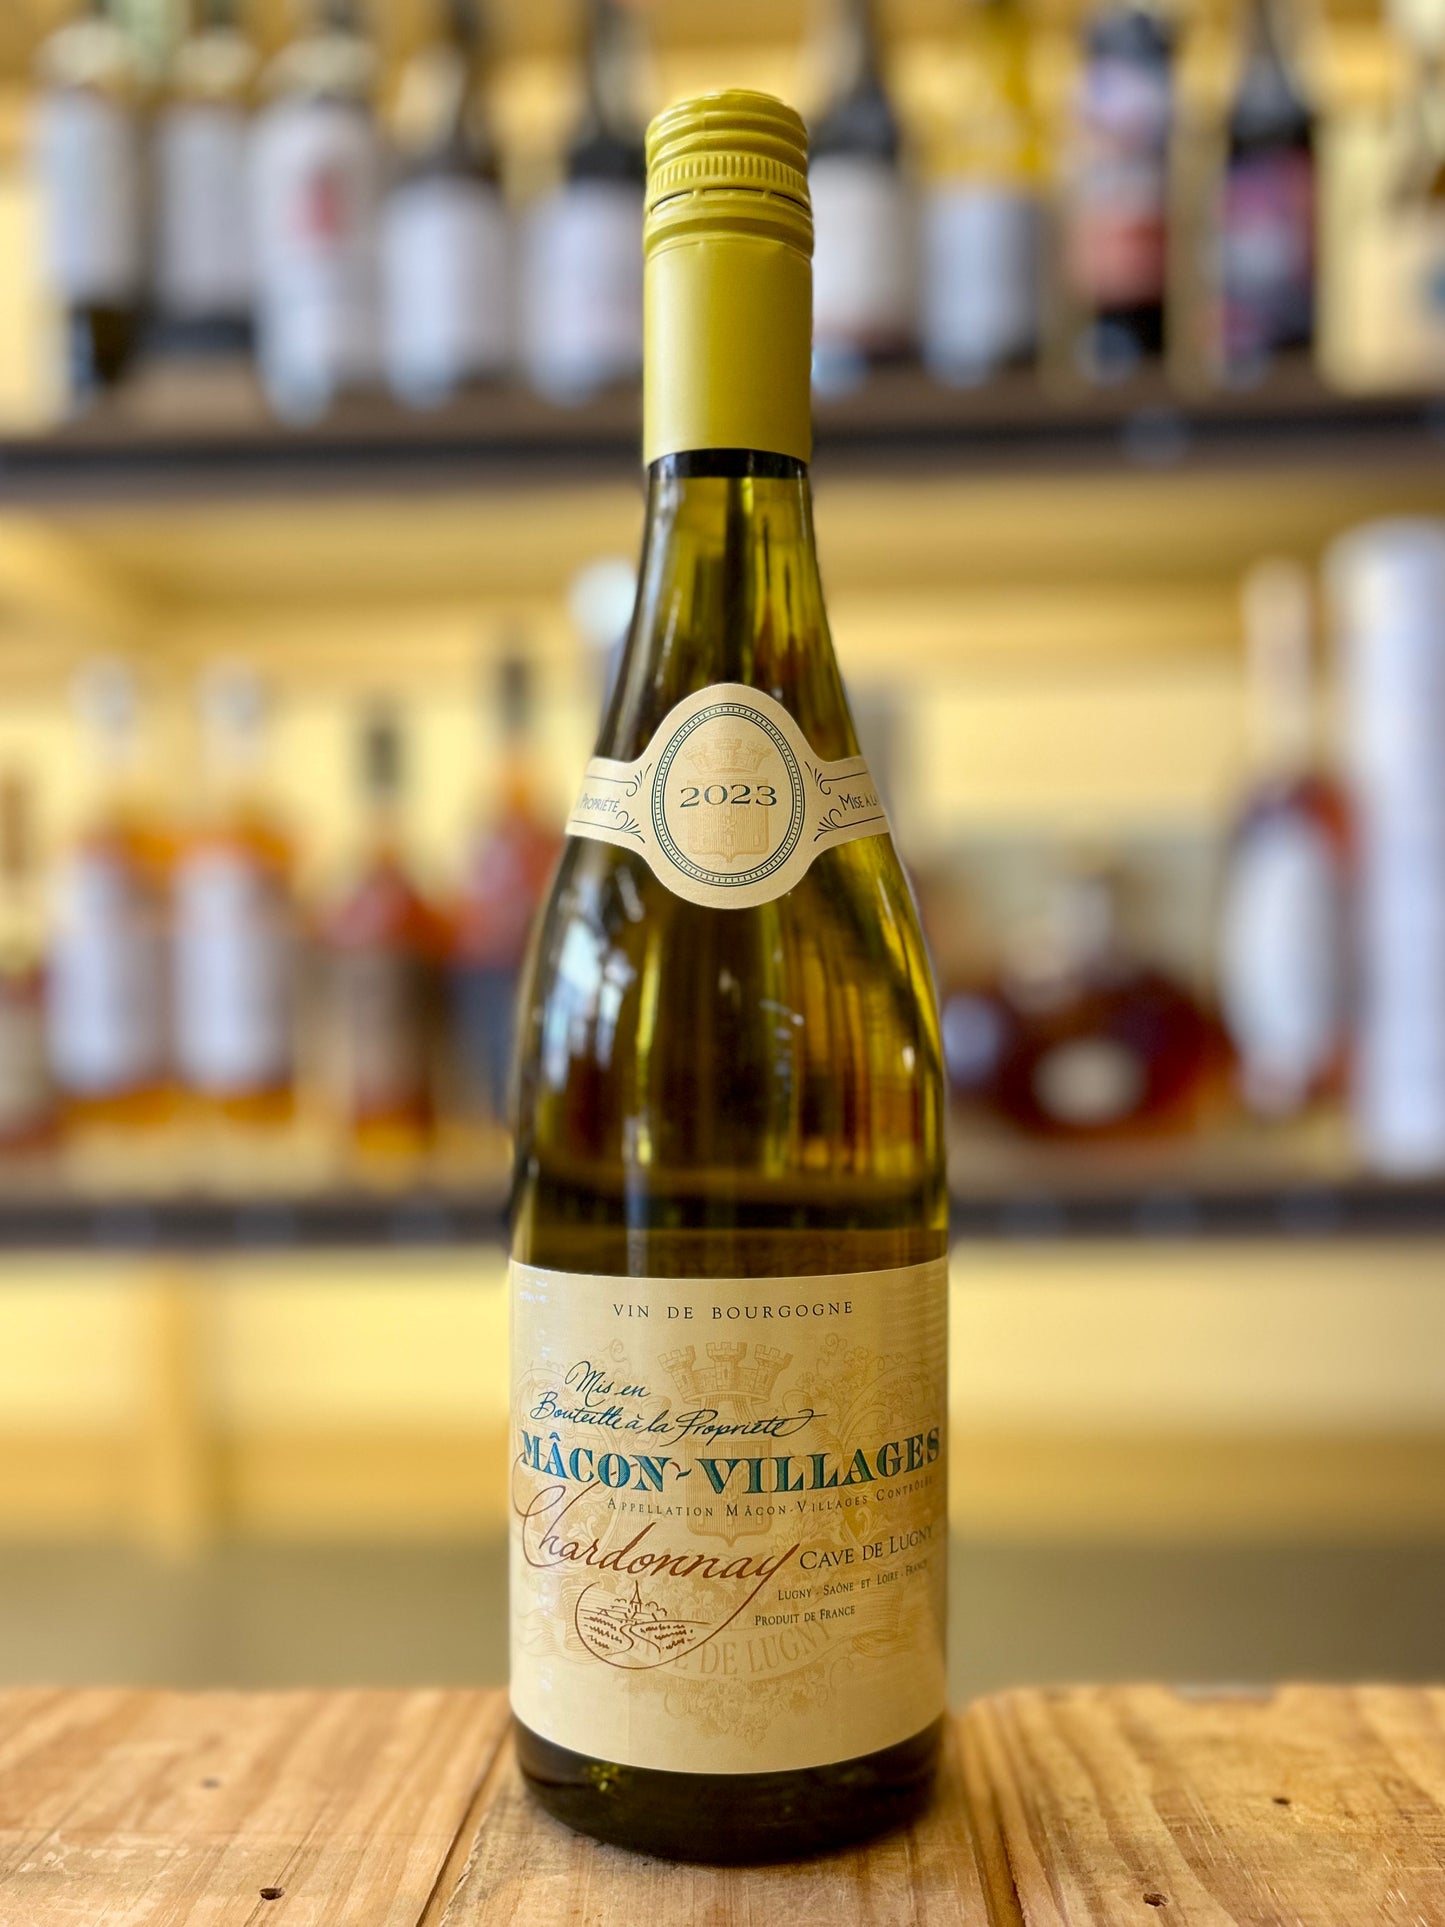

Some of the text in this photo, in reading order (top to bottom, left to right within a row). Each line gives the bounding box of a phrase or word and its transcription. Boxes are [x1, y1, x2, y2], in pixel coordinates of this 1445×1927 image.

[680, 784, 777, 808] 2023
[613, 1301, 853, 1320] VIN DE BOURGOGNE
[565, 1360, 651, 1407] Mis en
[530, 1391, 624, 1430] Bouteille
[624, 1413, 644, 1429] à
[635, 1410, 676, 1434] la
[607, 1497, 713, 1517] APPELLATION
[514, 1474, 799, 1590] Chardonnay
[799, 1526, 932, 1570] CAVE DE LUGNY
[777, 1588, 812, 1601] LUGNY
[823, 1581, 854, 1596] SAÔNE
[861, 1578, 870, 1589] ET
[877, 1570, 898, 1585] LOIRE
[754, 1605, 855, 1626] PRODUIT DE FRANCE
[699, 1640, 739, 1676] DE
[749, 1618, 832, 1674] LUGNY
